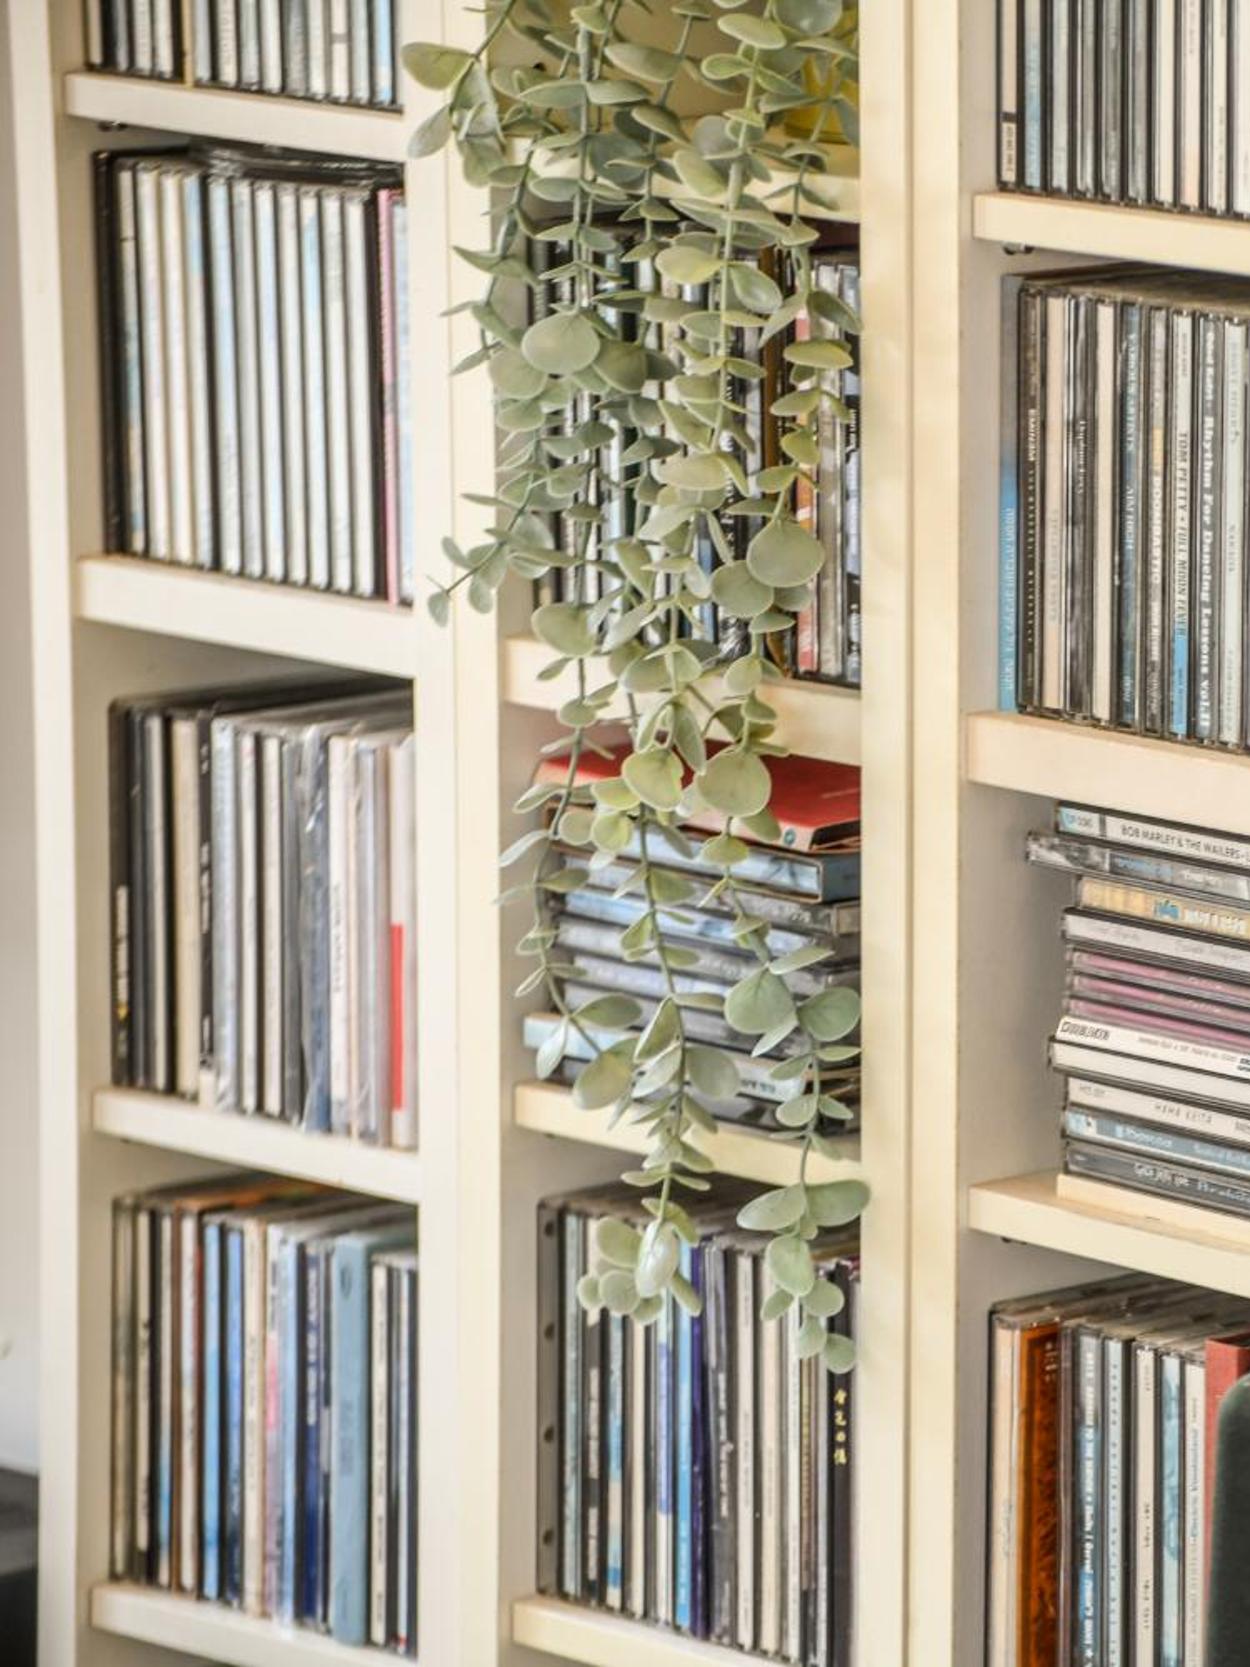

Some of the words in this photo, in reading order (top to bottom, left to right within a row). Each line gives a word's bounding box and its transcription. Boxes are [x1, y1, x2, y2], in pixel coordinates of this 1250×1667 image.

[1178, 430, 1188, 463] TOM
[1202, 416, 1215, 489] Rhythm
[1177, 467, 1187, 513] PETTY
[1203, 493, 1214, 525] For
[1177, 558, 1187, 595] MOON
[1199, 530, 1213, 603] Dancing
[1176, 599, 1187, 637] FEVER
[1200, 608, 1212, 674] Lessons
[1121, 824, 1140, 840] BOB
[1142, 829, 1176, 846] MARLEY
[1177, 836, 1185, 848] &
[1186, 838, 1200, 851] THE
[1203, 842, 1240, 860] WAILERS
